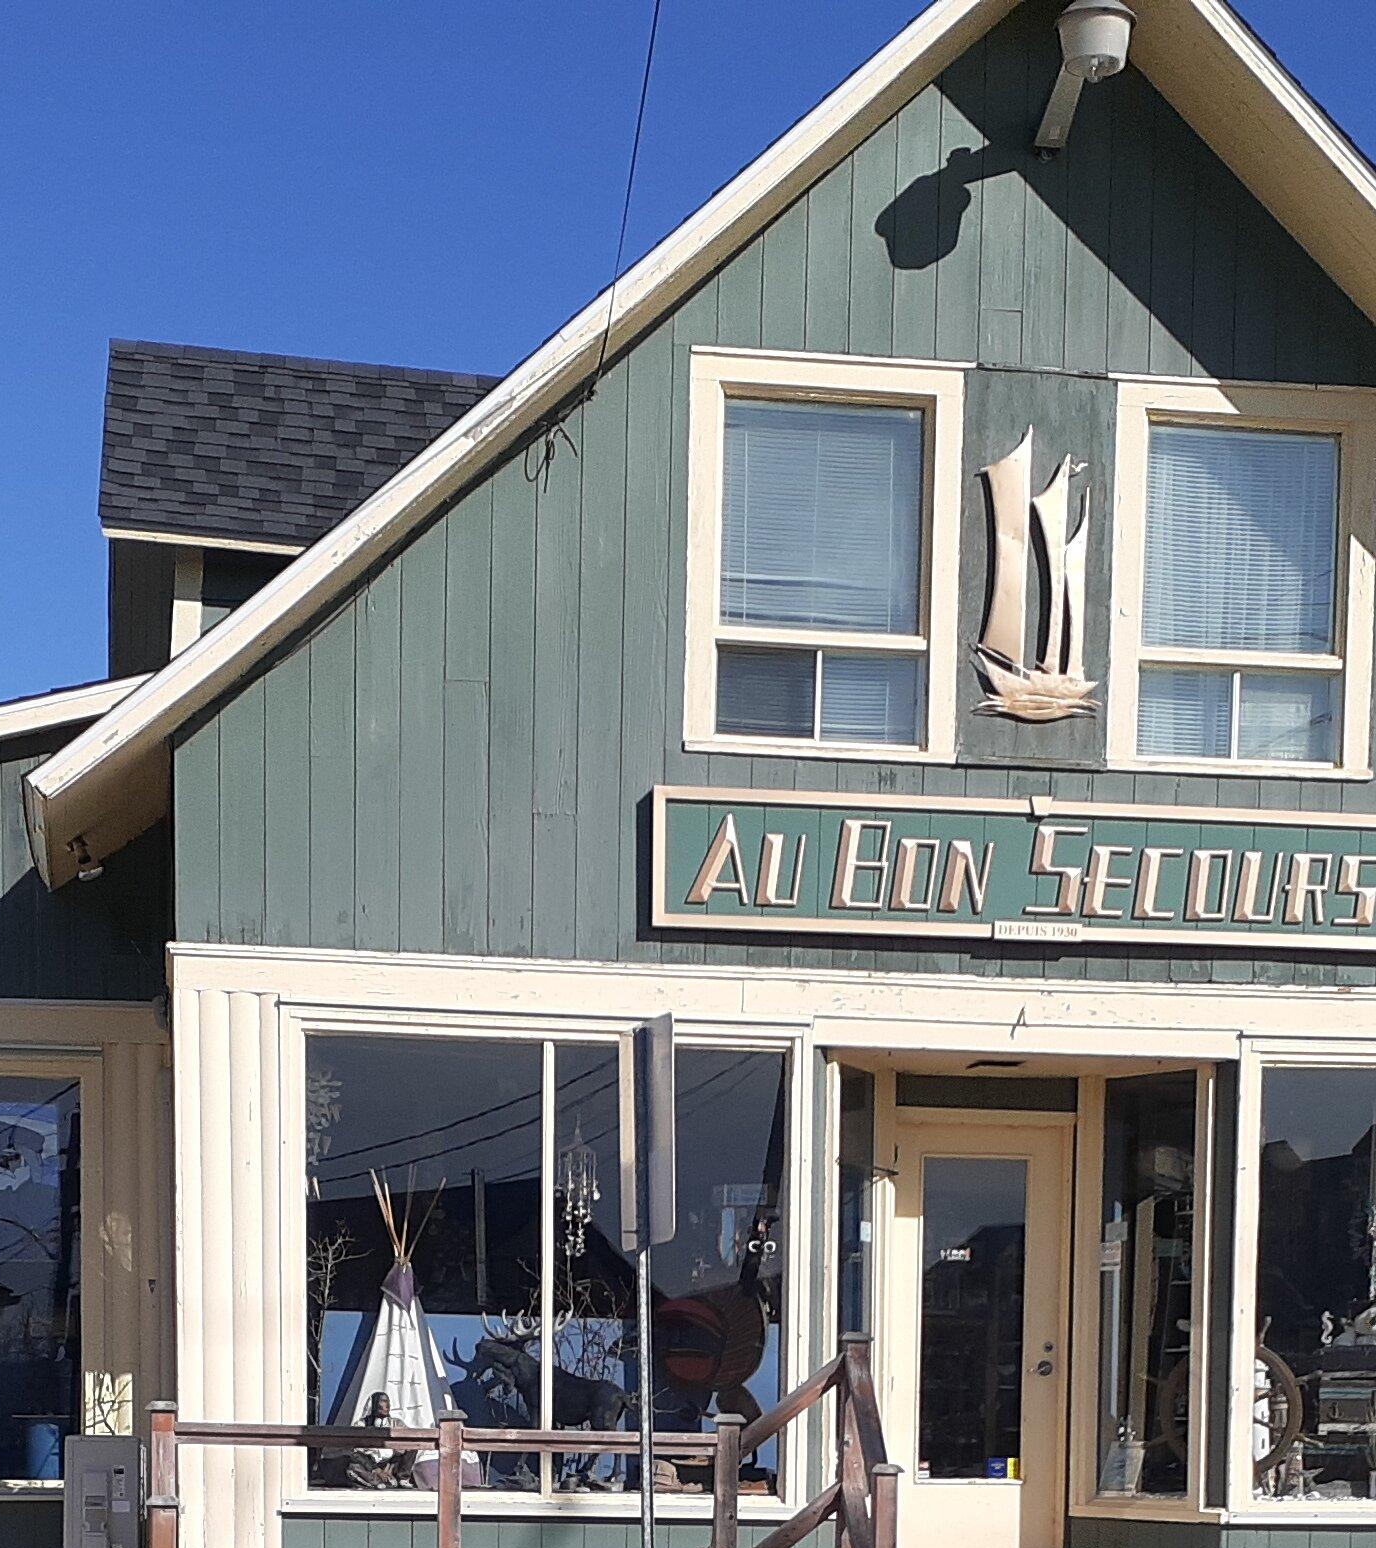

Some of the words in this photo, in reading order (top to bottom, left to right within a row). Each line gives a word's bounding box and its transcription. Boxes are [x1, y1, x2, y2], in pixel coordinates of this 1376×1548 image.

[684, 812, 806, 906] AU
[829, 818, 995, 914] BON
[998, 924, 1048, 937] DEPUIS
[1051, 926, 1078, 937] 1930
